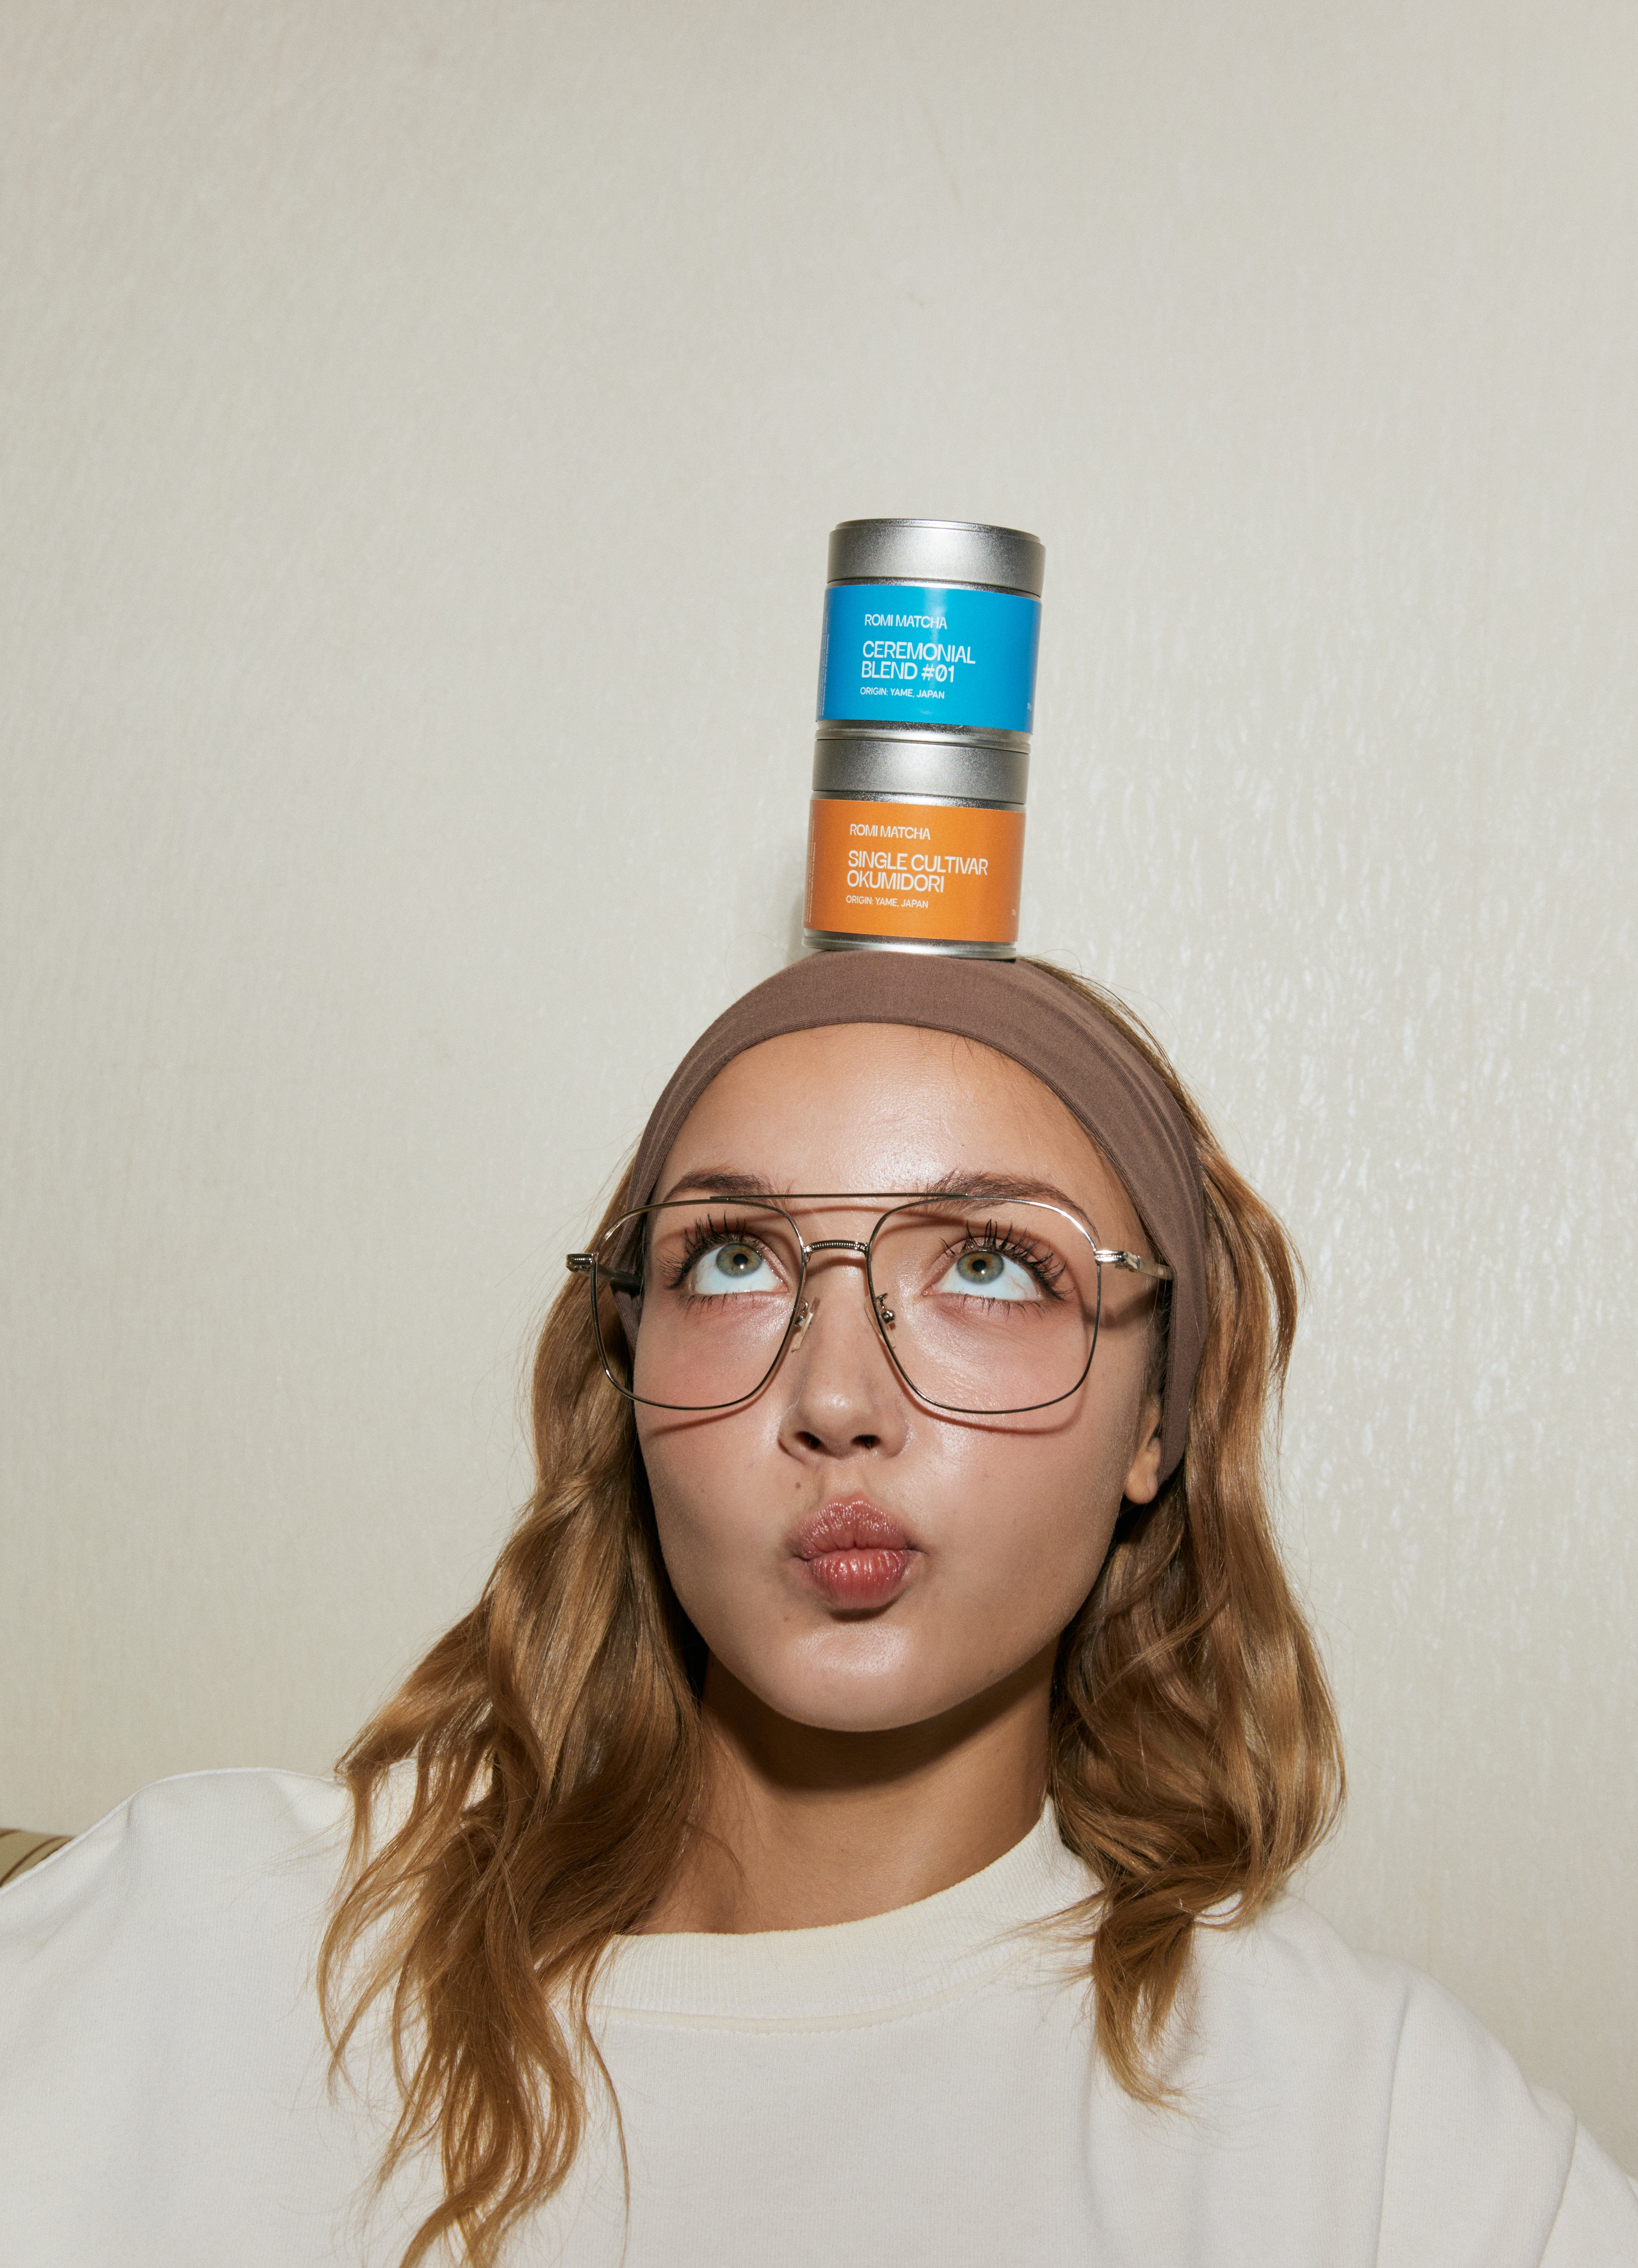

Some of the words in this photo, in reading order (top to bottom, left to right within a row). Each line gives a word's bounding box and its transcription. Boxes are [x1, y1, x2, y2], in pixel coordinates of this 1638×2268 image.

[865, 614, 893, 626] ROMI
[896, 614, 947, 629] MATCHA
[862, 641, 975, 664] CEREMONIAL
[862, 661, 918, 679] BLEND
[922, 664, 954, 682] #01
[860, 687, 888, 695] ORIGIN:
[891, 688, 914, 697] YAME,
[917, 690, 945, 699] JAPAN
[850, 824, 878, 836] ROMI
[880, 826, 930, 839] MATCHA
[849, 850, 908, 870] SINGLE
[911, 854, 988, 875] CULTIVAR
[847, 870, 944, 892] OKUMIDORI
[846, 895, 874, 904] ORIGIN:
[876, 897, 899, 907] YAME,
[901, 899, 928, 908] JAPAN
